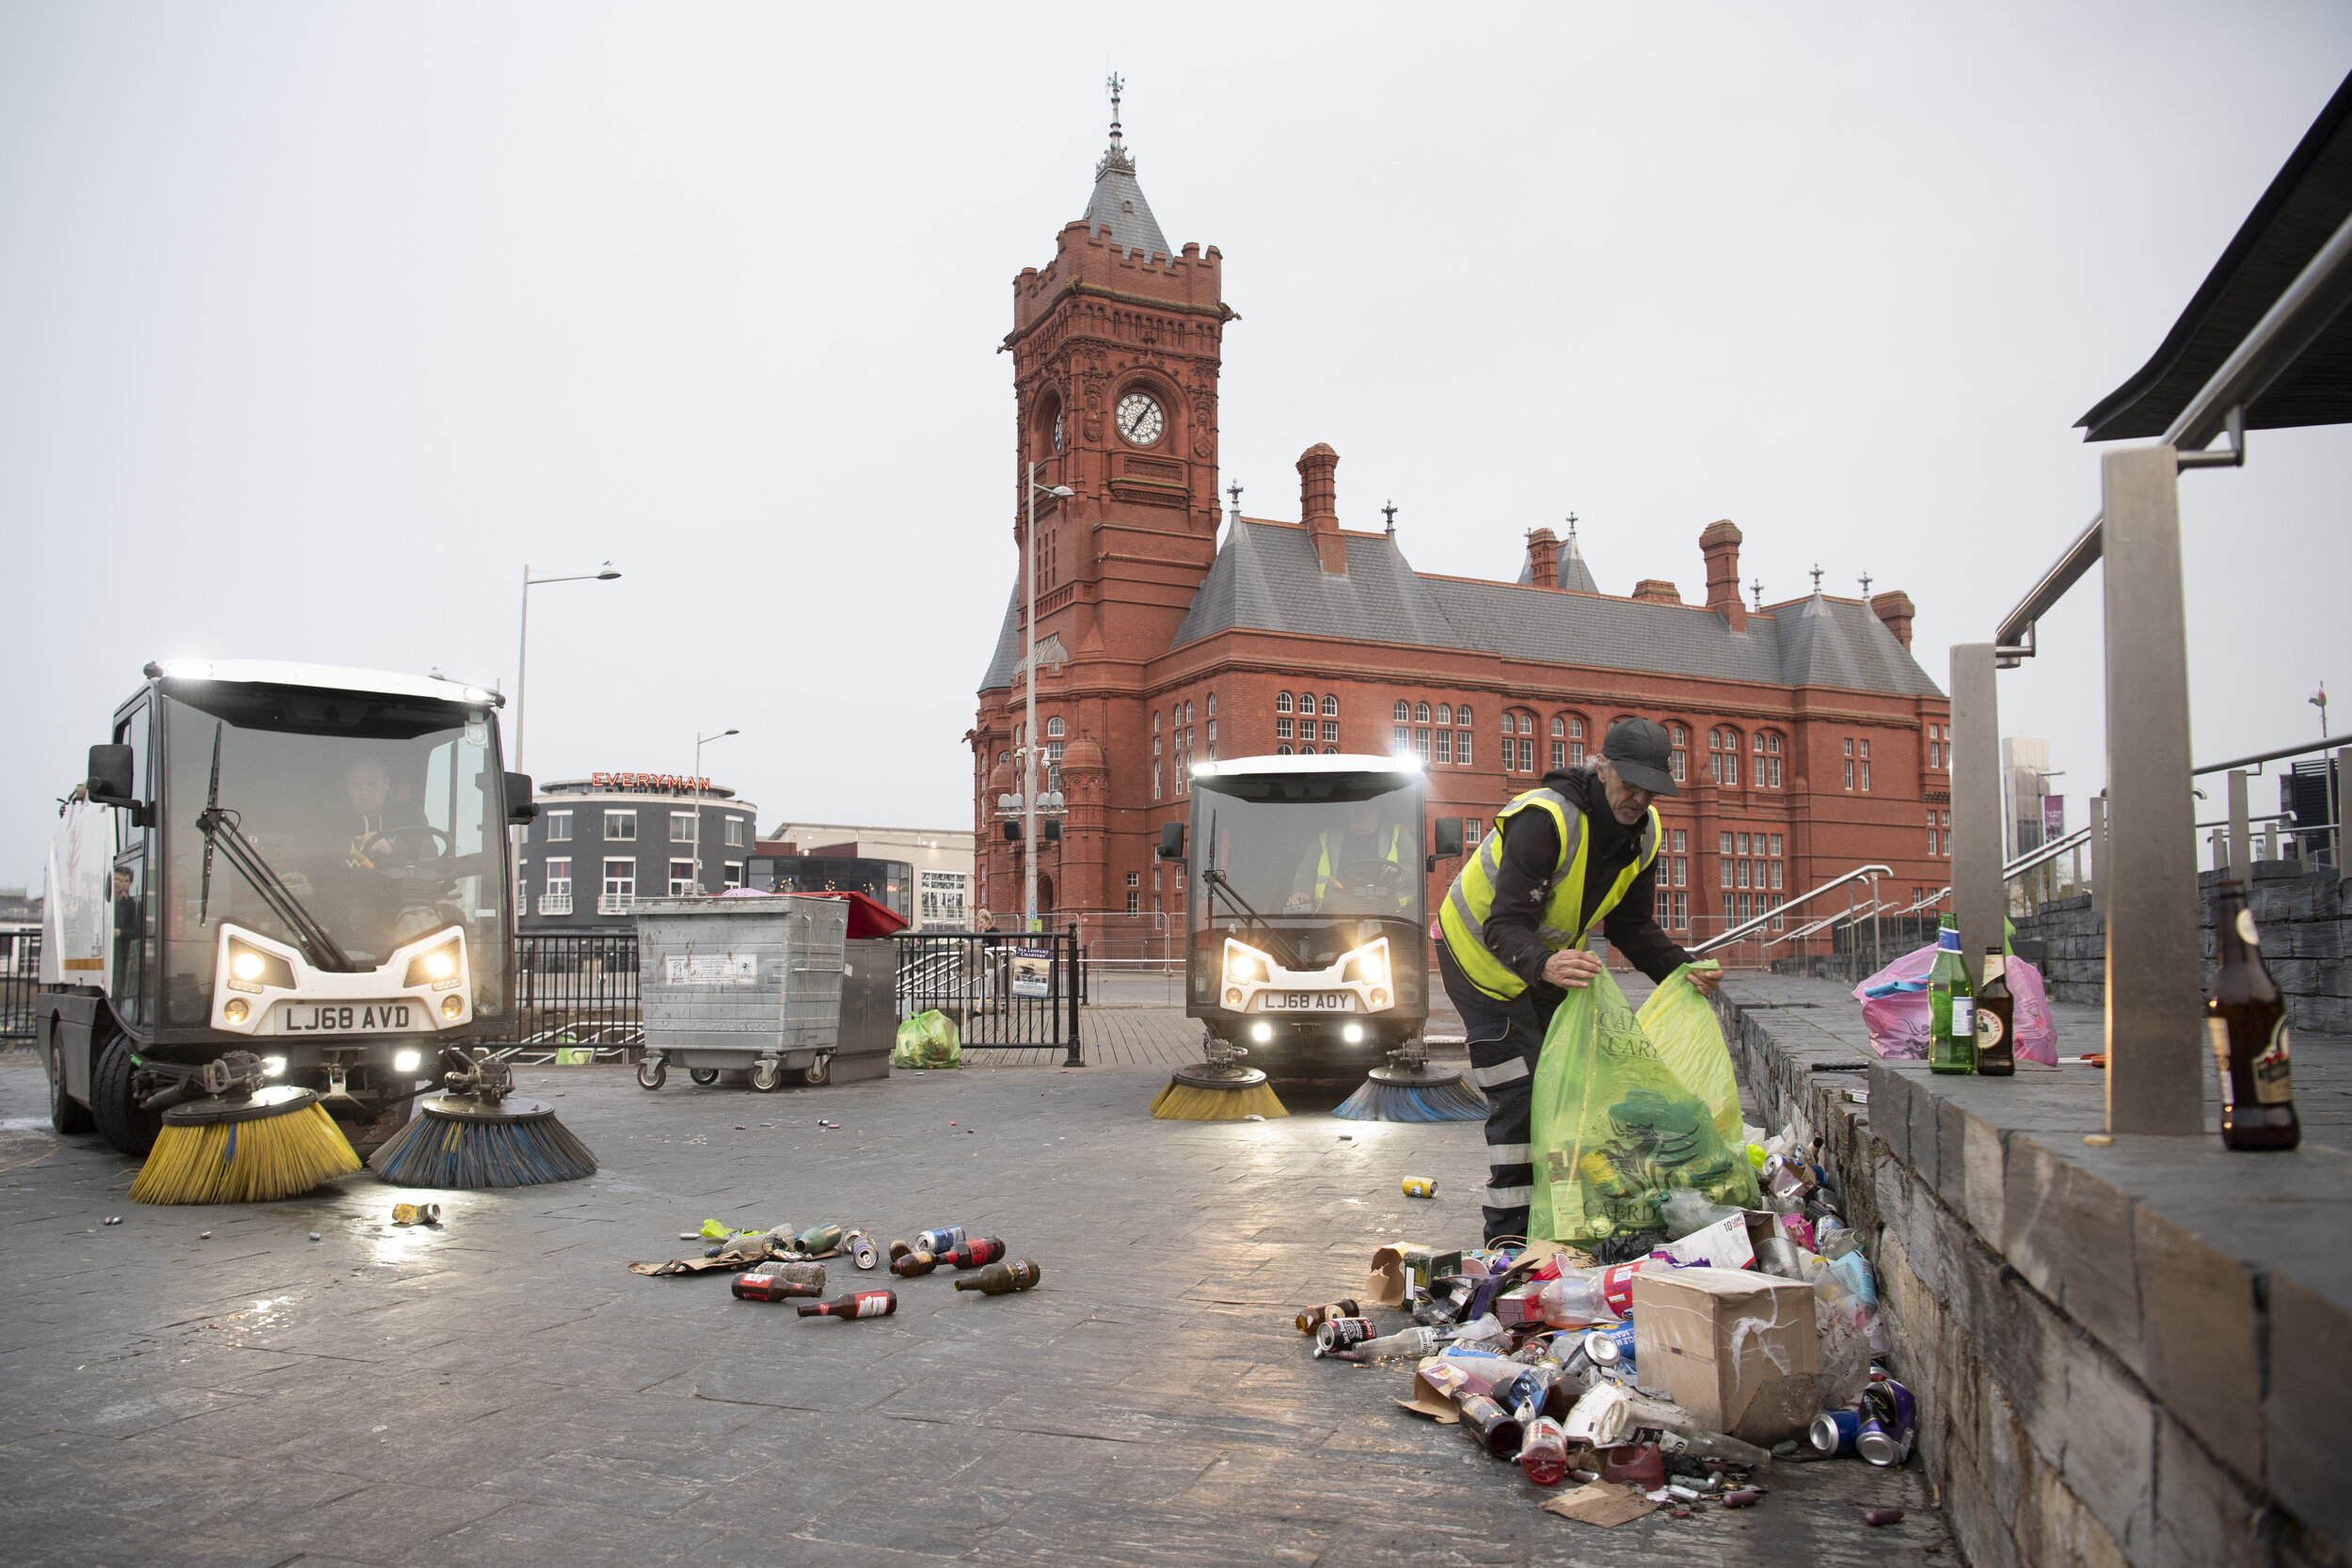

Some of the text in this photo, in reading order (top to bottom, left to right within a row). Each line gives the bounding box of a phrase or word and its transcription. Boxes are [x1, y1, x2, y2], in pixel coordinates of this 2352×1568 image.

[593, 773, 709, 790] EVERYMAN
[1265, 994, 1348, 1008] LJ68 AOY
[287, 1006, 409, 1031] LJ68 AVD
[1608, 1036, 1657, 1058] CAR
[1583, 1201, 1661, 1221] CAERD
[1724, 1221, 1733, 1232] 10
[1420, 1330, 1429, 1355] Corona
